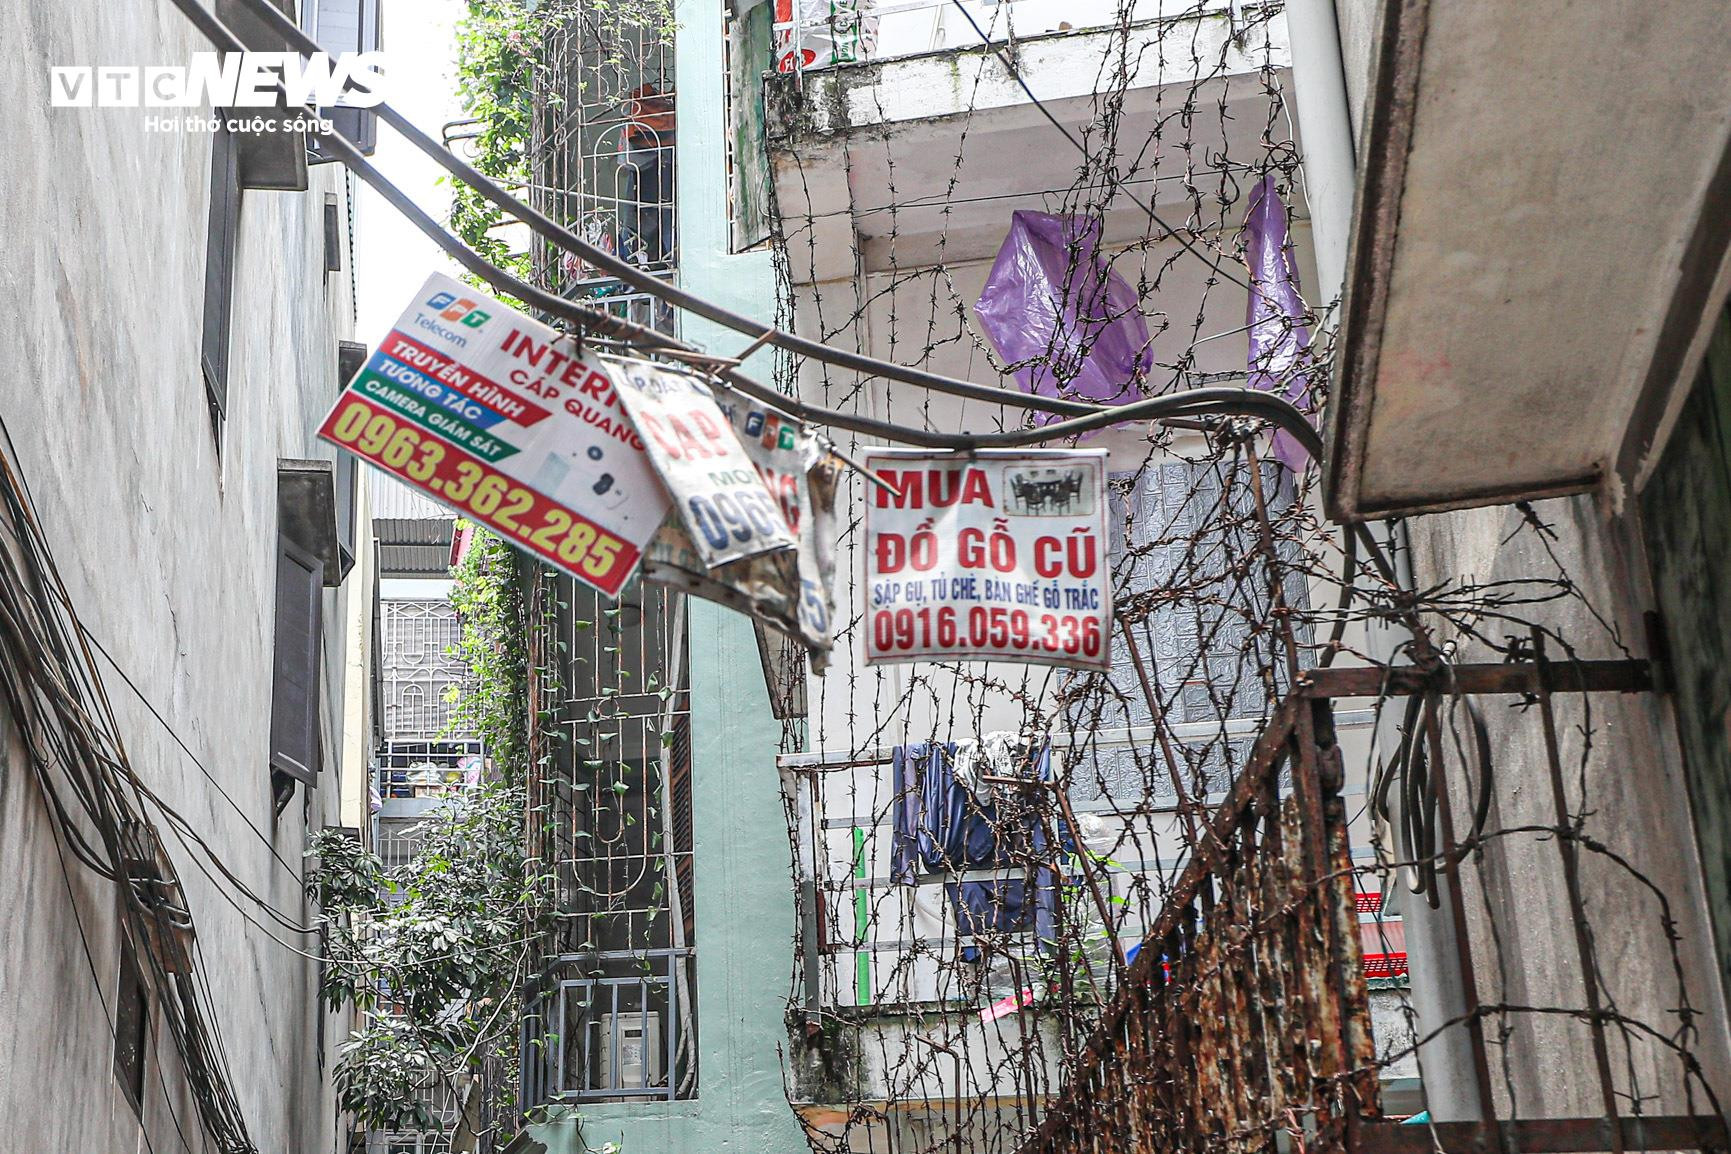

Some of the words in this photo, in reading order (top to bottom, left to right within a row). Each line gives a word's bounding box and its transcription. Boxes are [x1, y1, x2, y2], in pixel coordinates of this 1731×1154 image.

[414, 313, 468, 348] Telecom
[427, 292, 492, 329] FPT
[378, 359, 444, 398] TƯƠNG
[444, 391, 483, 420] TÁC
[468, 380, 526, 418] HÌNH
[365, 379, 426, 418] CAMERA
[428, 412, 471, 441] GIÁM
[470, 434, 503, 457] SÁT
[745, 410, 796, 451] FPT
[332, 402, 624, 578] 0963.362.285
[874, 465, 995, 510] MUA
[875, 517, 940, 575] ĐỒ
[957, 517, 1017, 574] GỖ
[1033, 526, 1097, 579] CŨ
[984, 575, 1012, 603] BÀN
[1015, 578, 1040, 607] GHẾ
[873, 606, 1101, 659] 0916.059.336
